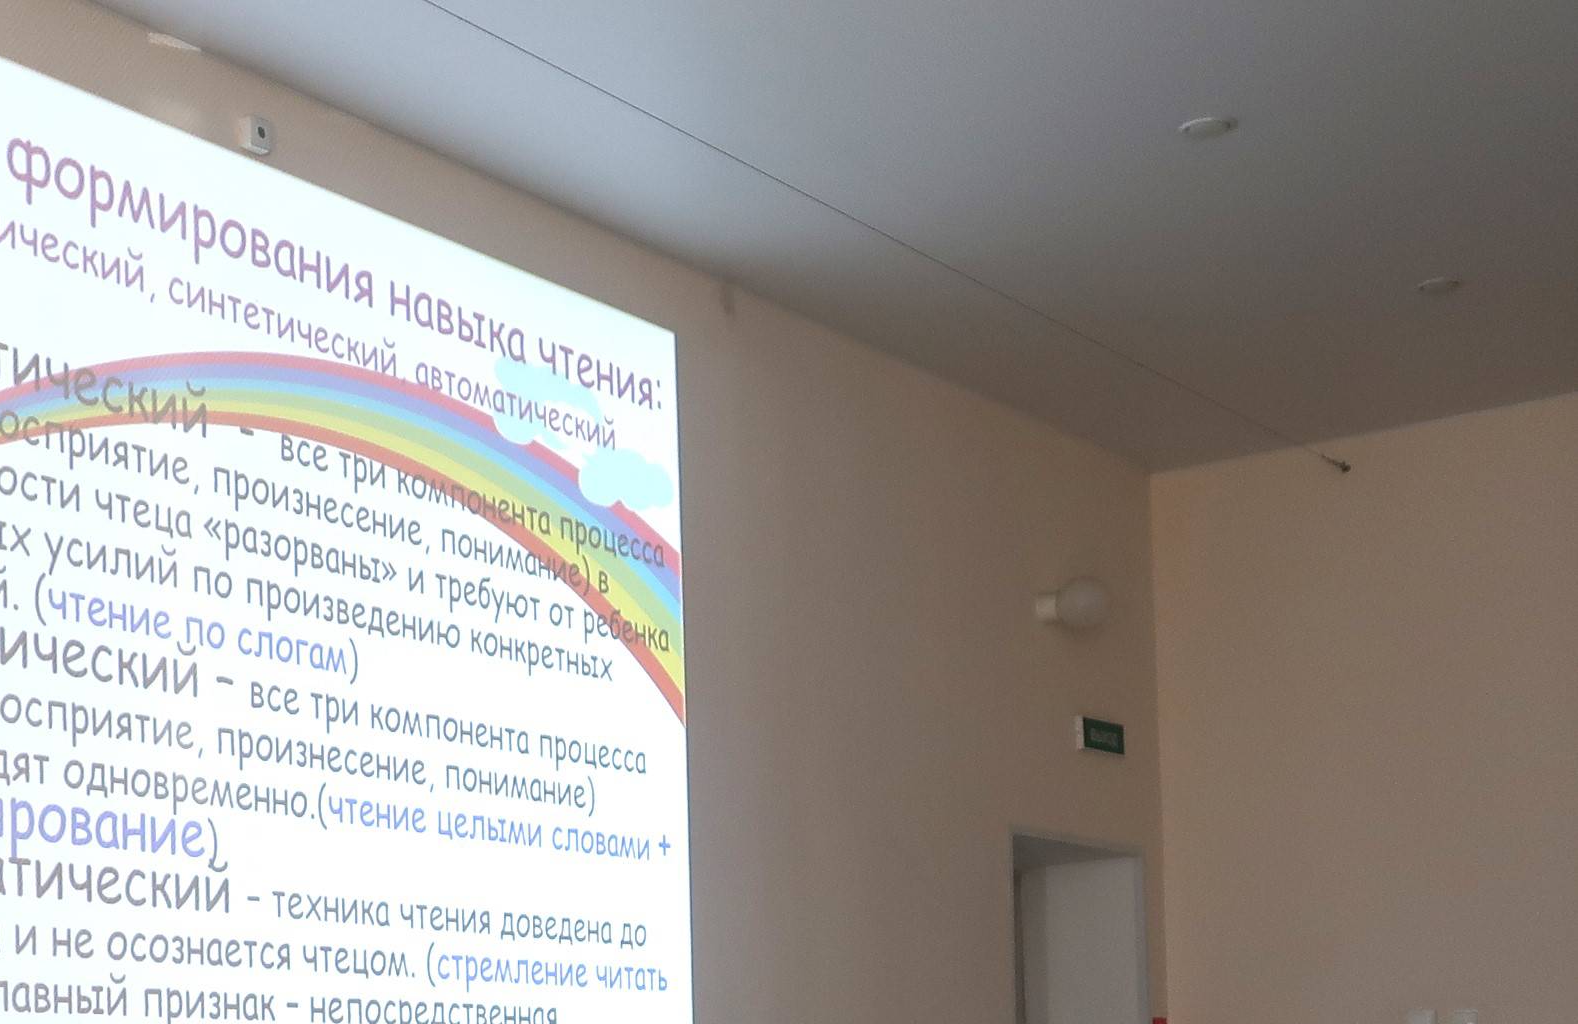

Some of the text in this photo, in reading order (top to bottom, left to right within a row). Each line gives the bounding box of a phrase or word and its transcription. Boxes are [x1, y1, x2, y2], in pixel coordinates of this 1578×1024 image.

[6, 139, 374, 305] формирования
[388, 281, 527, 363] навыка
[537, 338, 662, 409] чтения:
[414, 362, 616, 449] автоматический
[212, 466, 430, 553] произнесение,
[440, 528, 591, 595] понимание)
[598, 572, 609, 593] в
[279, 434, 329, 471] все
[337, 451, 392, 493] три
[396, 470, 551, 535] компонента
[559, 516, 665, 567] процесса
[44, 533, 179, 587] усилий
[193, 565, 233, 598] по
[244, 578, 461, 648] произведению
[469, 629, 614, 680] конкретных
[95, 489, 193, 538] чтеца
[203, 518, 398, 582] «разорваны»
[407, 567, 424, 594] и
[434, 573, 541, 622] требуют
[548, 602, 575, 628] от
[582, 608, 670, 652] ребенка
[33, 574, 172, 639] (чтение
[185, 616, 226, 649] по
[236, 628, 360, 683] слогам)
[216, 727, 435, 791] произнесение,
[444, 764, 596, 815] понимание)
[248, 681, 300, 715] все
[310, 692, 359, 733] три
[369, 704, 530, 754] компонента
[538, 734, 647, 774] процесса
[437, 811, 542, 847] целыми
[551, 826, 650, 859] словами
[658, 834, 671, 856] +
[13, 924, 38, 955] и
[50, 927, 95, 959] не
[105, 931, 292, 969] осознается
[302, 945, 416, 978] чтецом.
[426, 942, 588, 990] (стремление
[595, 965, 668, 991] читать
[272, 890, 390, 926] техника
[398, 903, 491, 934] чтения
[499, 912, 613, 944] доведена
[619, 922, 647, 949] до
